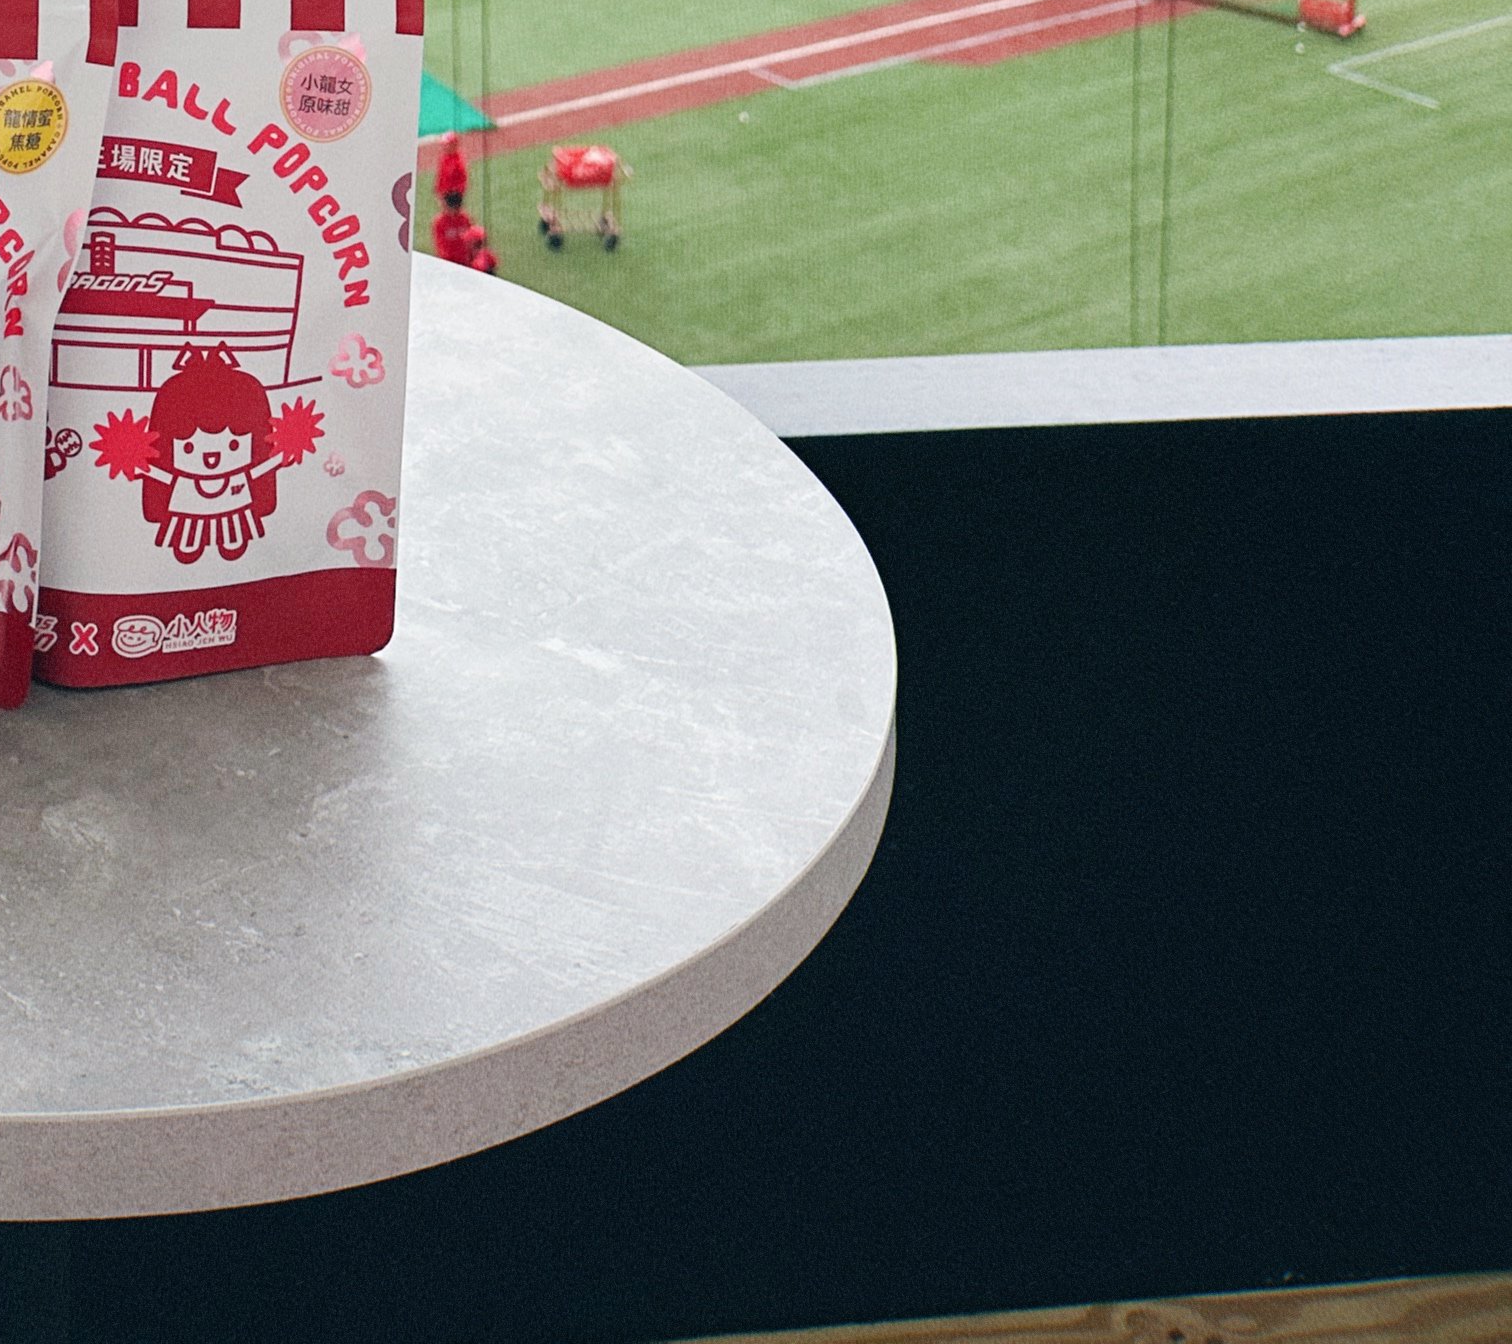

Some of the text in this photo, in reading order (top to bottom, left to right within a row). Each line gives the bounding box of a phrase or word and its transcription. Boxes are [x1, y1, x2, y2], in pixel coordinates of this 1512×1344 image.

[301, 73, 354, 96] 小龍女
[299, 95, 351, 116] 原味甜
[8, 132, 41, 152] 焦糖
[118, 61, 370, 308] BALL POPCORN
[71, 273, 170, 293] AGONS
[167, 610, 235, 639] 小人物
[165, 639, 194, 650] HSIAO
